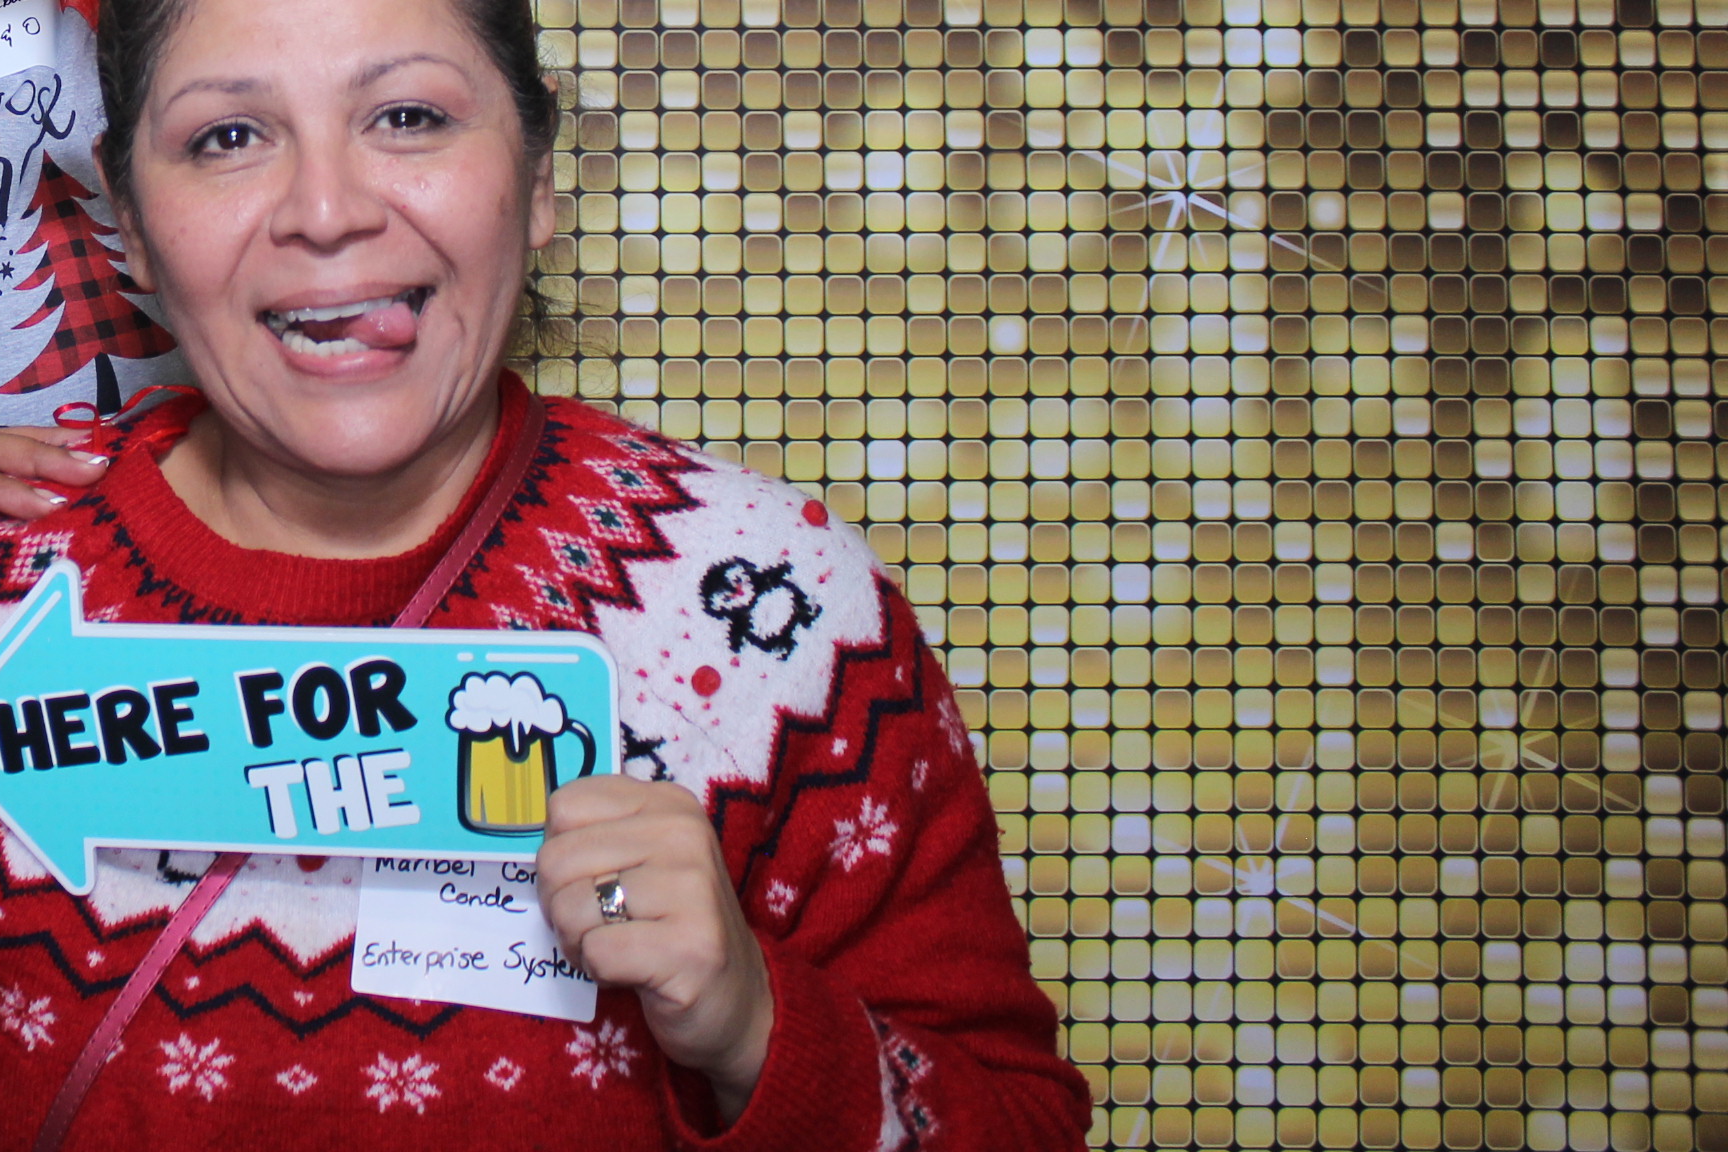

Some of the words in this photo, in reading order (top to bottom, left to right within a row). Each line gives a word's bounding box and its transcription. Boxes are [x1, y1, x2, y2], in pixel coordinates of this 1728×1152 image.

[233, 655, 419, 749] FOR
[244, 748, 422, 840] THE
[439, 882, 529, 914] Conde
[361, 940, 489, 978] Enterprise
